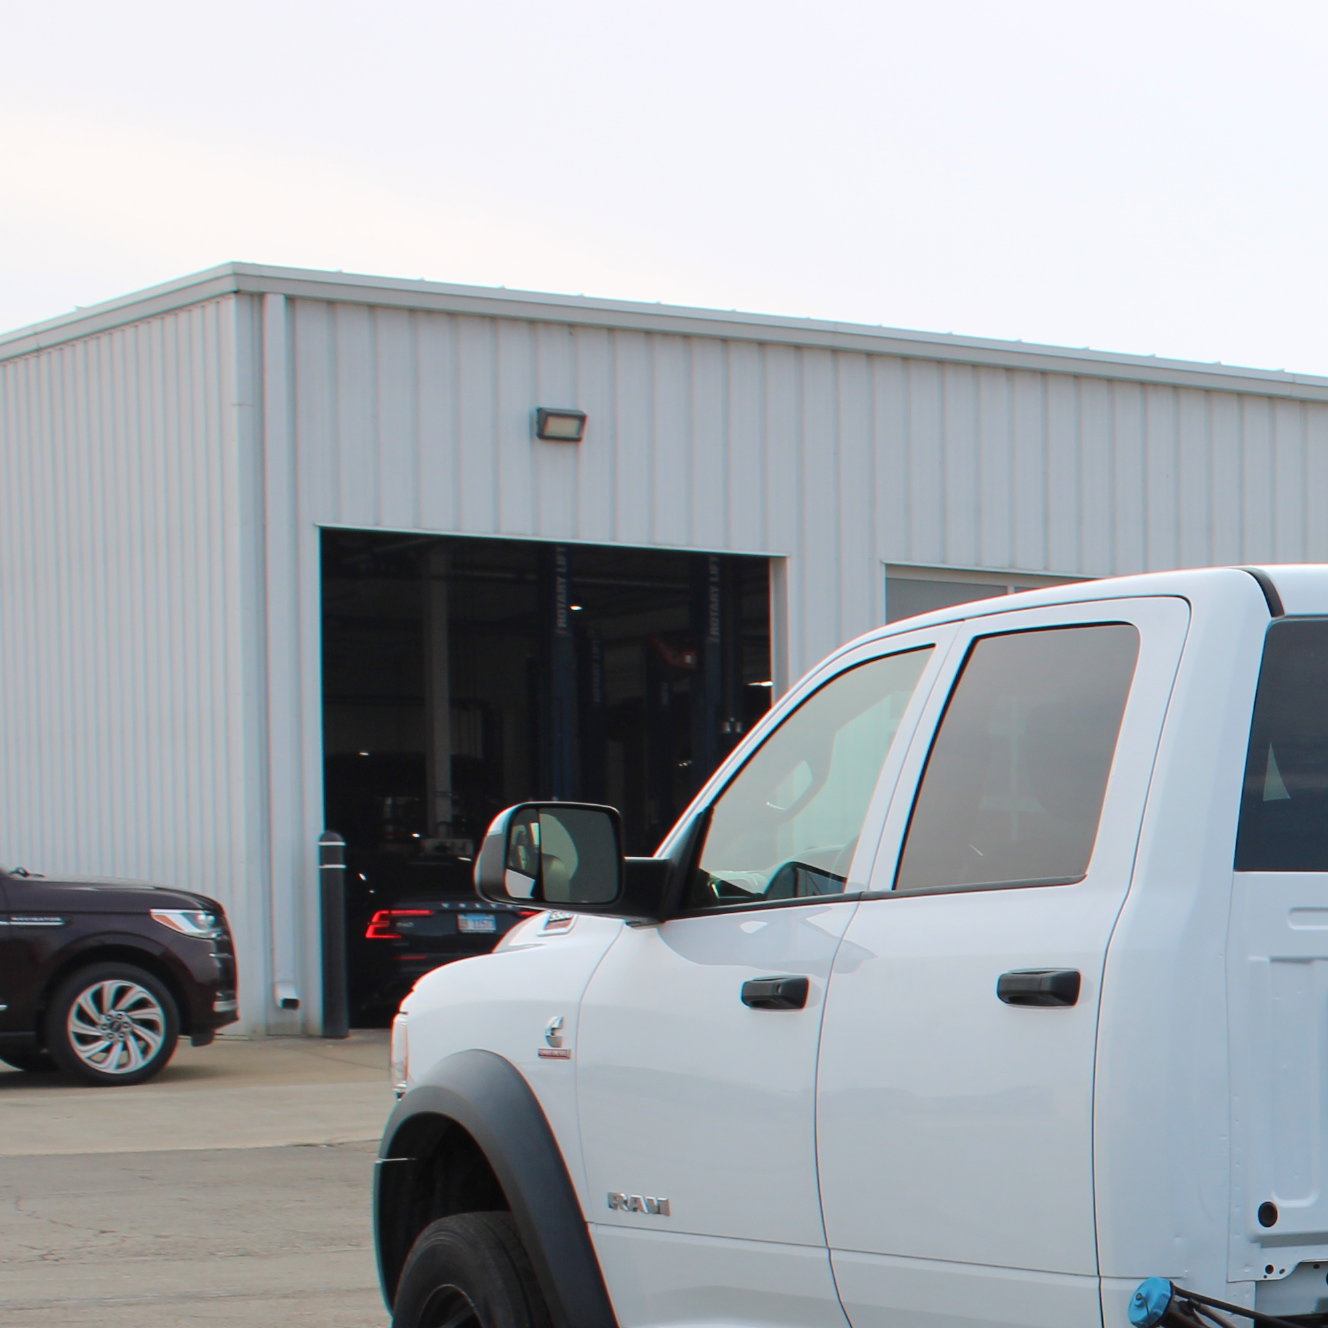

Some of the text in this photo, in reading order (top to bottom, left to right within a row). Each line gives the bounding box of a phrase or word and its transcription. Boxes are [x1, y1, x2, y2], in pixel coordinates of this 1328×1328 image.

[555, 546, 567, 628] ROTARY LIFT
[708, 586, 719, 635] ROTARY
[608, 1192, 671, 1216] RAM
